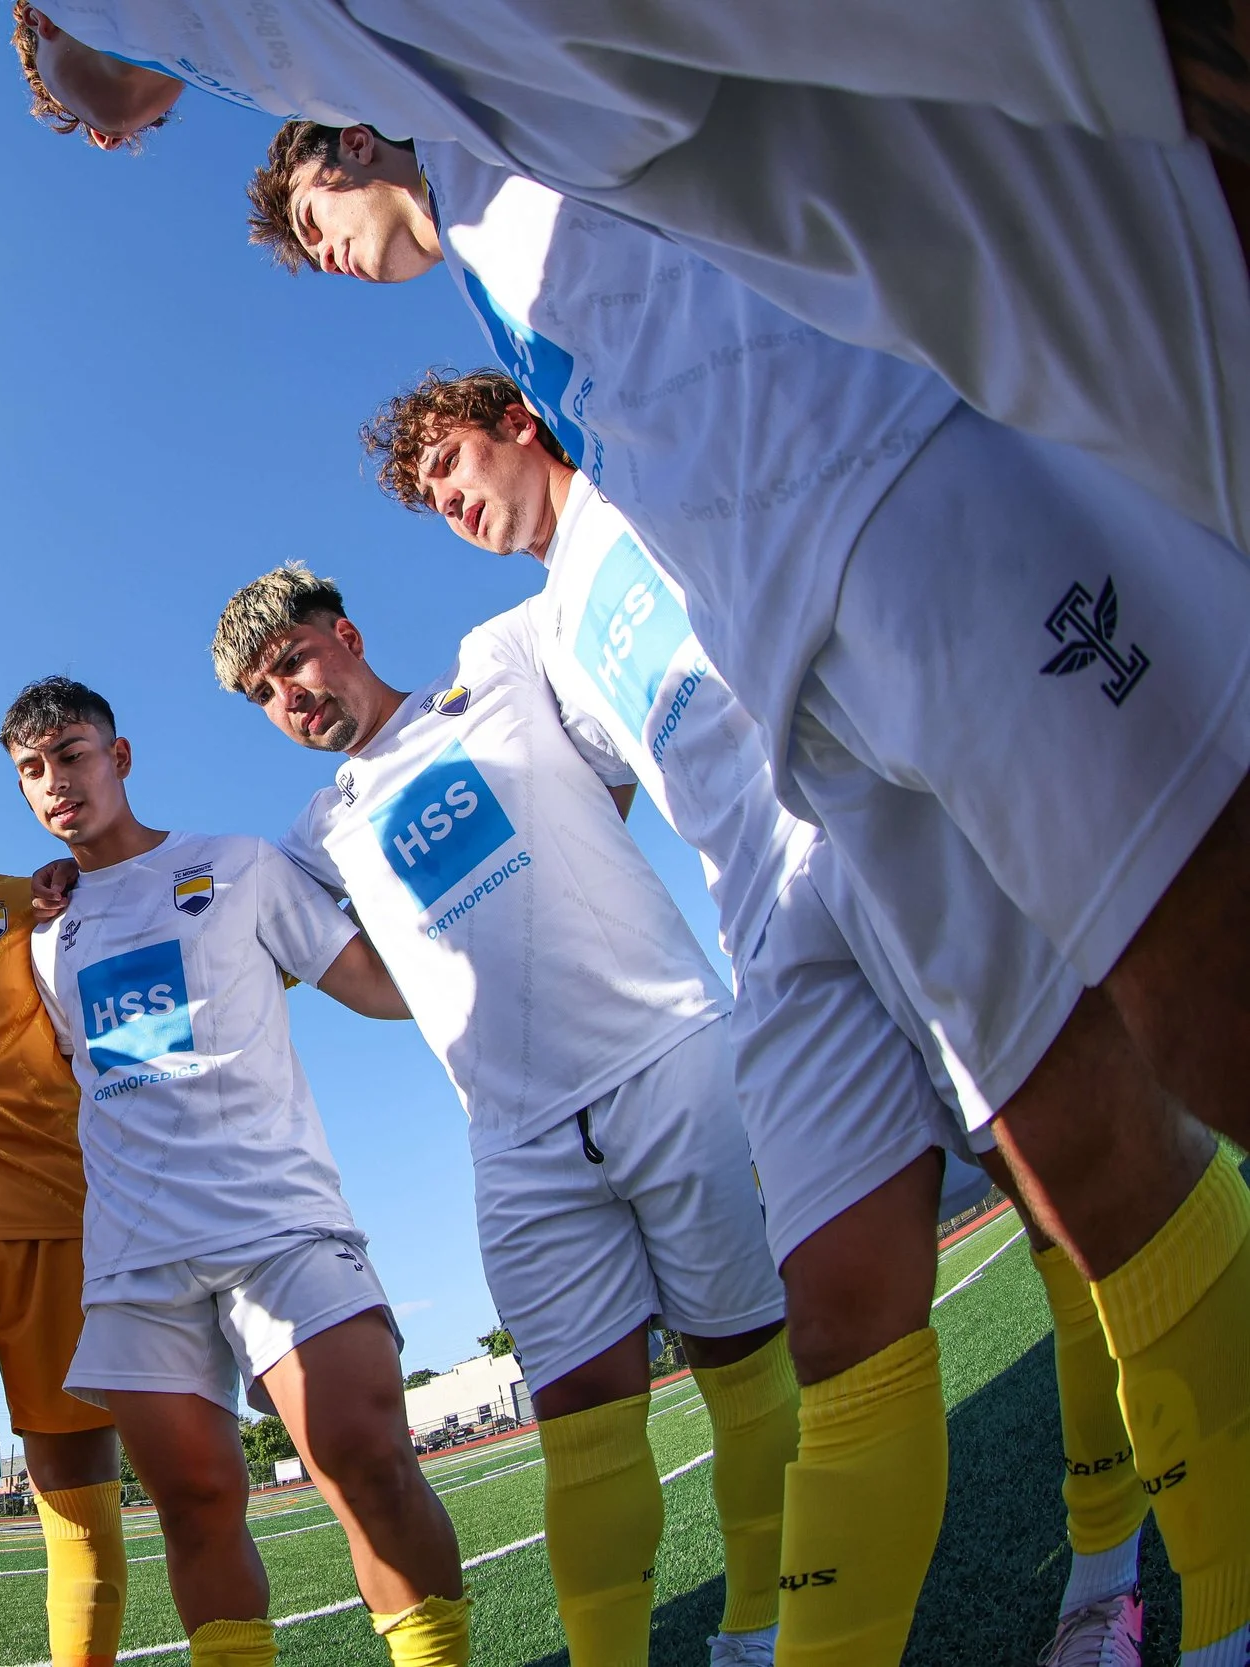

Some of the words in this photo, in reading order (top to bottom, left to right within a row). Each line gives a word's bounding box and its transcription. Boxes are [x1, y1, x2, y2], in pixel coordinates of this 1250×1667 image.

[597, 583, 655, 697] HSS
[652, 657, 708, 774] RTHOPEDIC
[393, 780, 478, 868] HSS
[426, 851, 532, 940] ORTHOPEDICS
[93, 983, 176, 1034] HSS
[93, 1063, 200, 1102] ORTHOPEDICS
